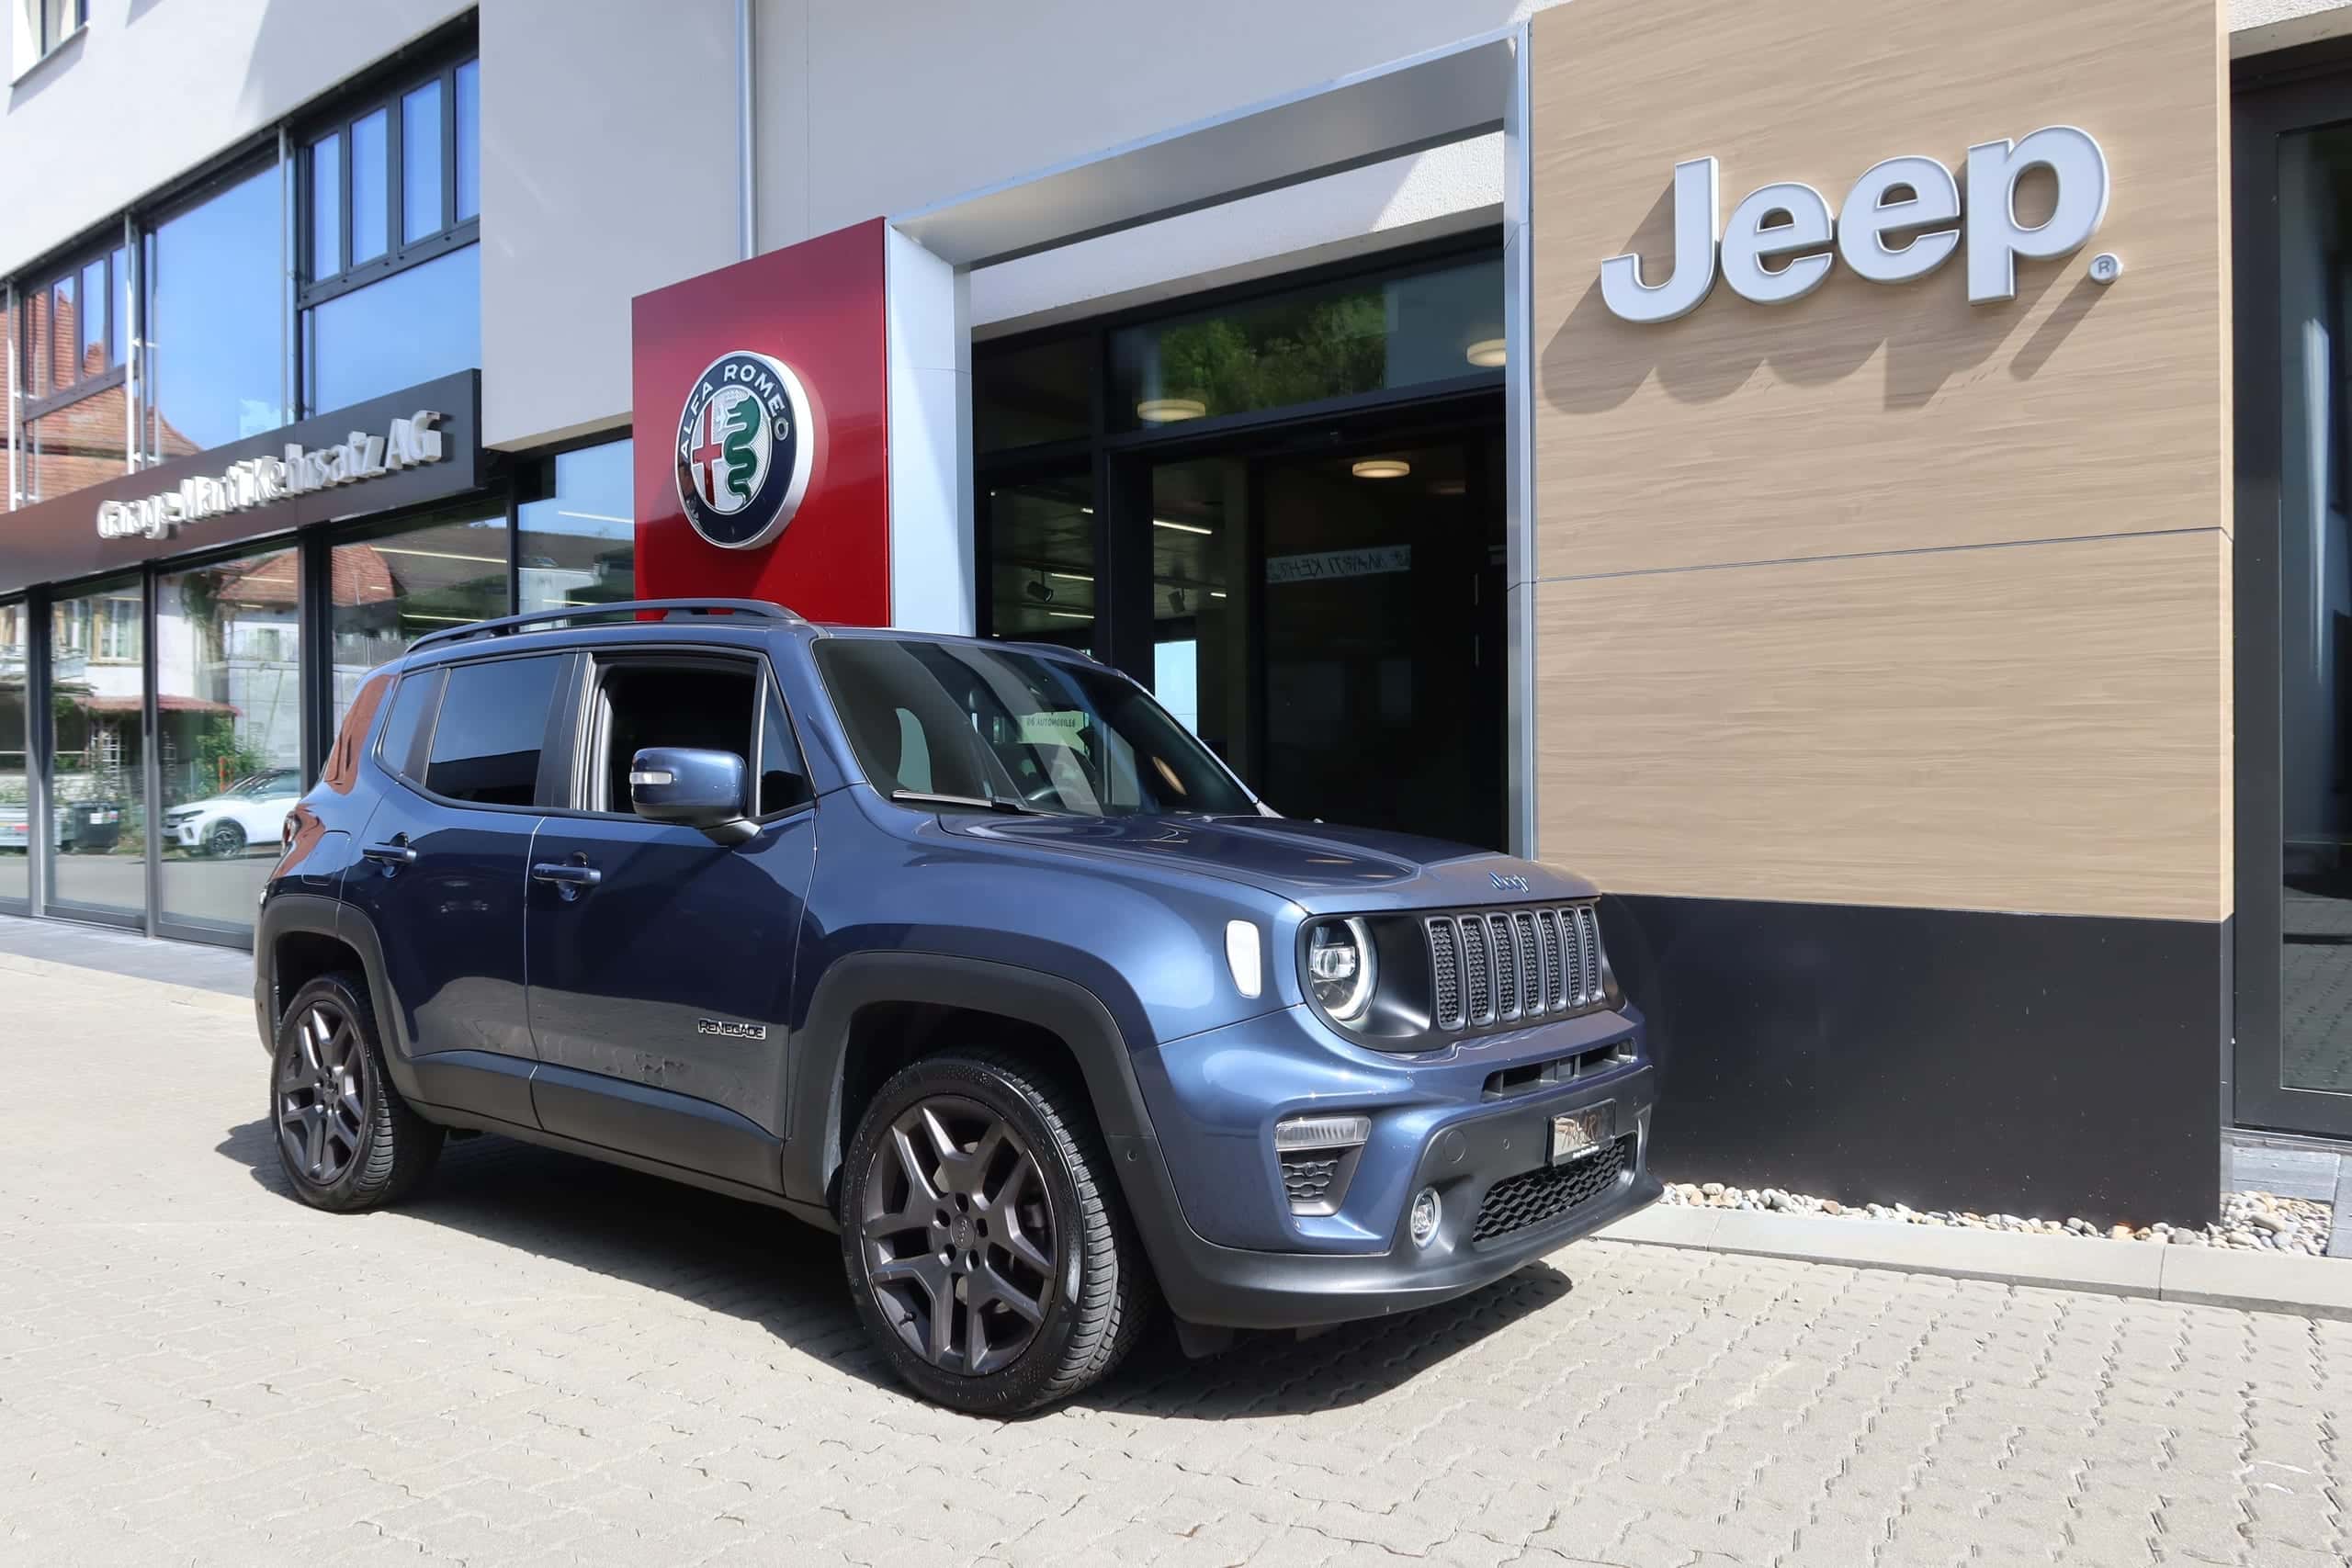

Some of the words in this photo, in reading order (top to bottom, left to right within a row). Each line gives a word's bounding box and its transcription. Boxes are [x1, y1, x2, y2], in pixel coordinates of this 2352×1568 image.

[1601, 124, 2110, 324] Jeep
[96, 492, 183, 540] Garage
[180, 460, 254, 521] Marti
[252, 431, 387, 502] Kehrsatz
[385, 410, 442, 470] AG
[680, 381, 714, 459] ALFA
[723, 364, 789, 441] ROMEO
